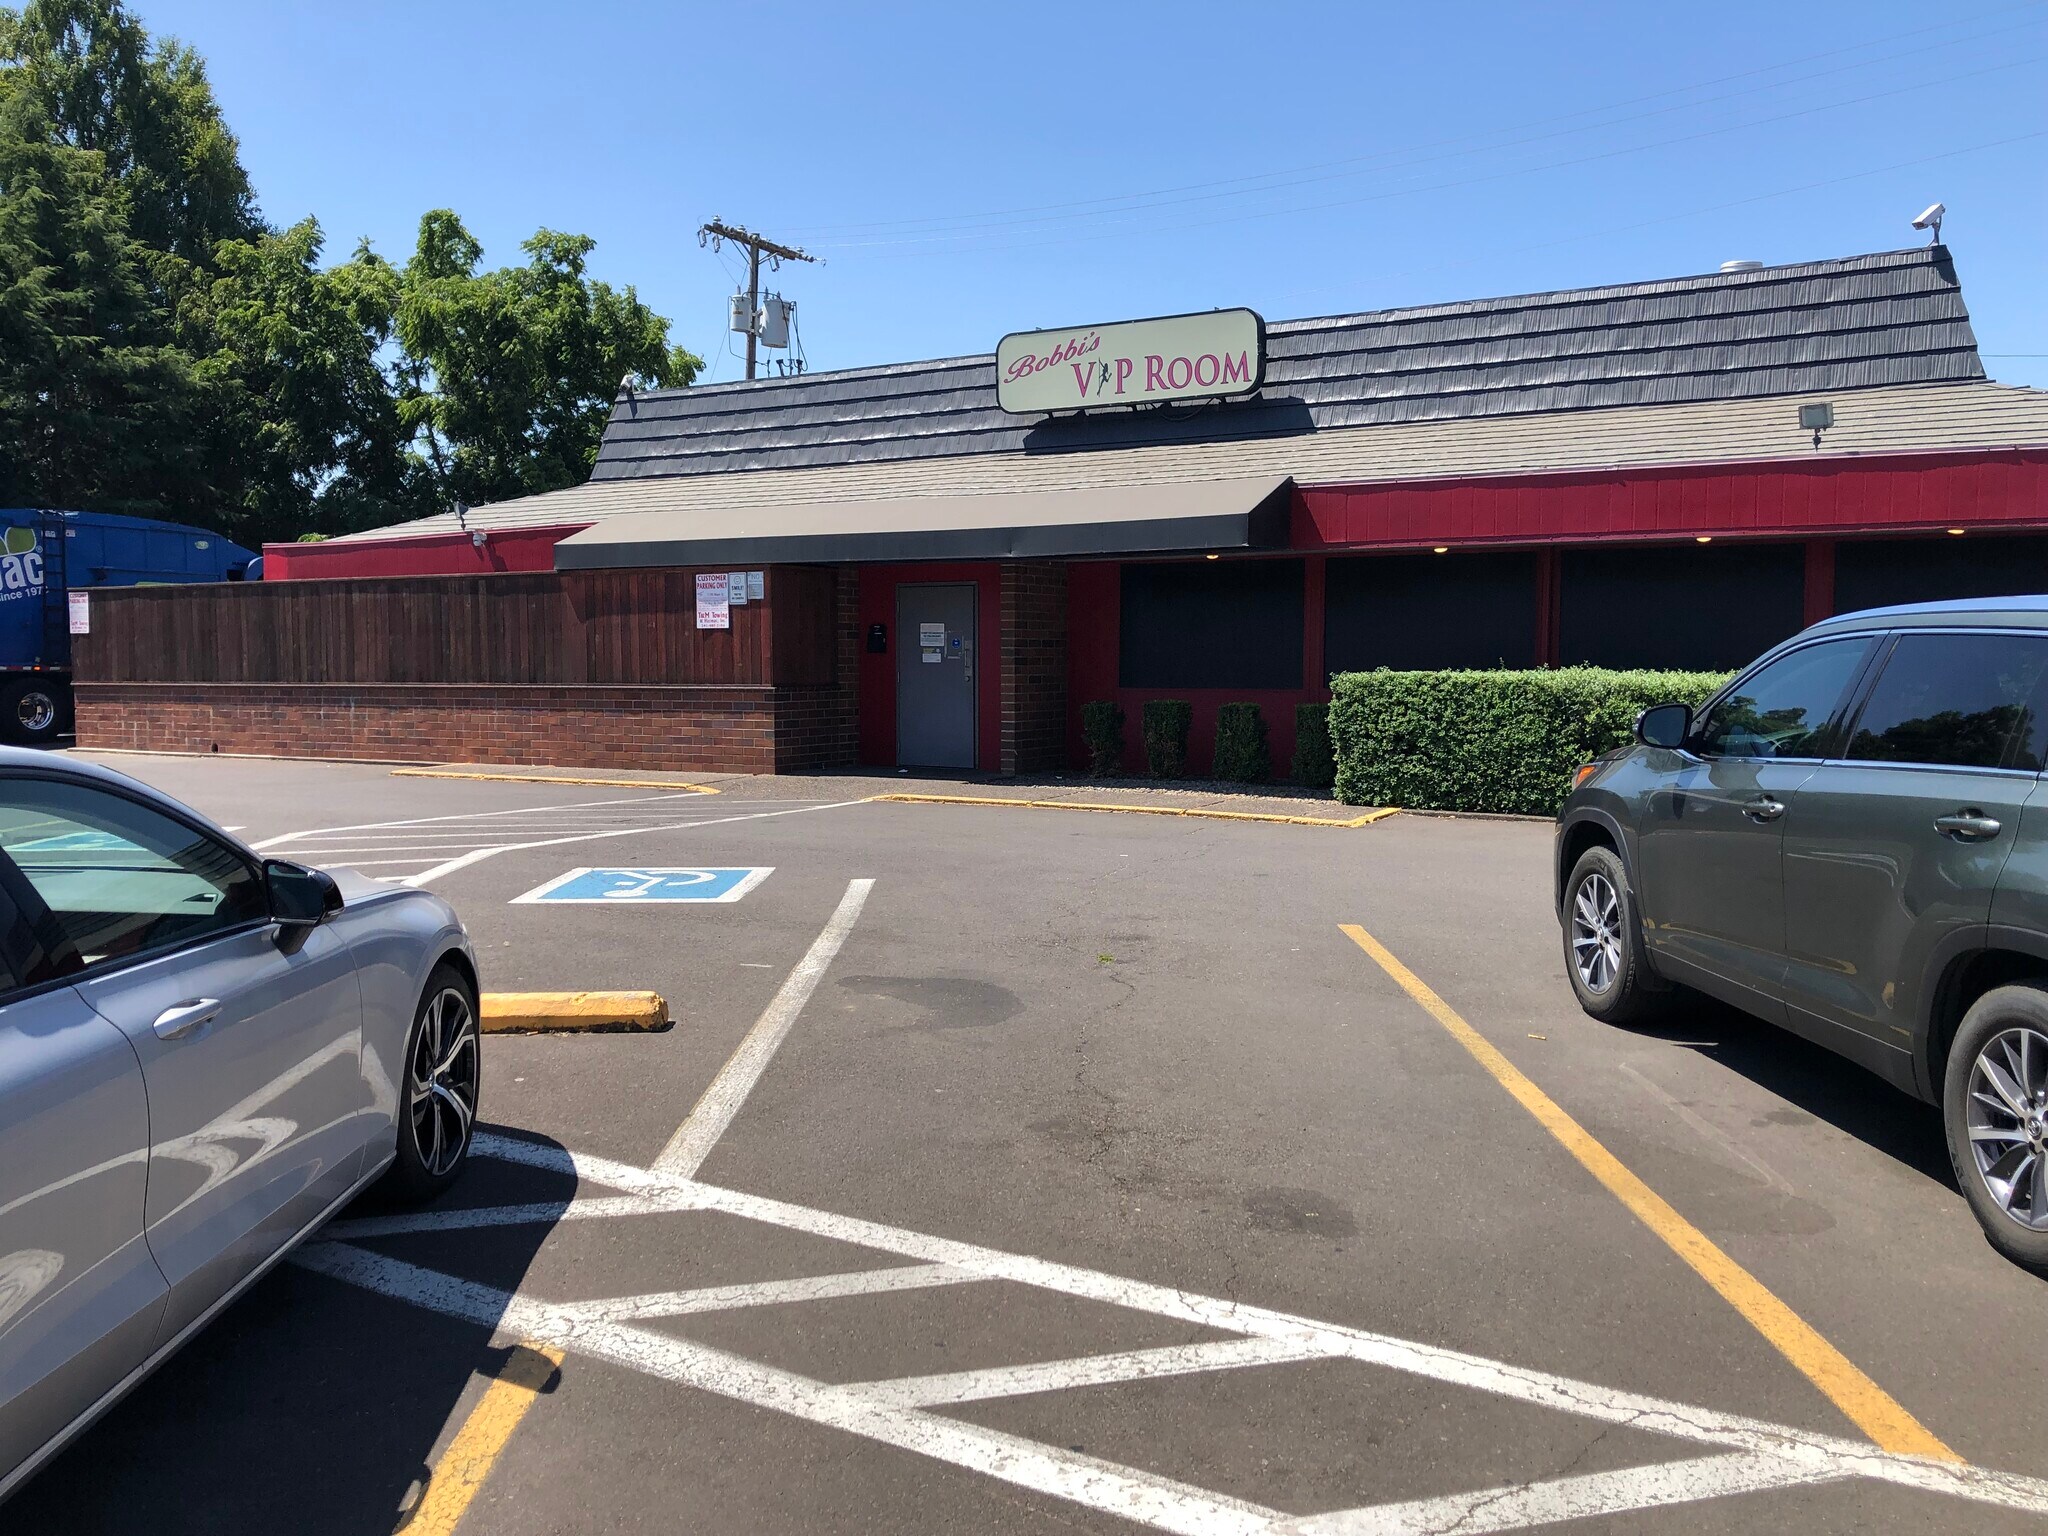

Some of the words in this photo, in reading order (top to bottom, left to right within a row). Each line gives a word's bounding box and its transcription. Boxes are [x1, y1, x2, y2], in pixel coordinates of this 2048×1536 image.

[1003, 331, 1101, 384] Bobbi's
[1144, 350, 1252, 392] ROOM
[0, 552, 44, 591] ac
[0, 591, 23, 601] ince
